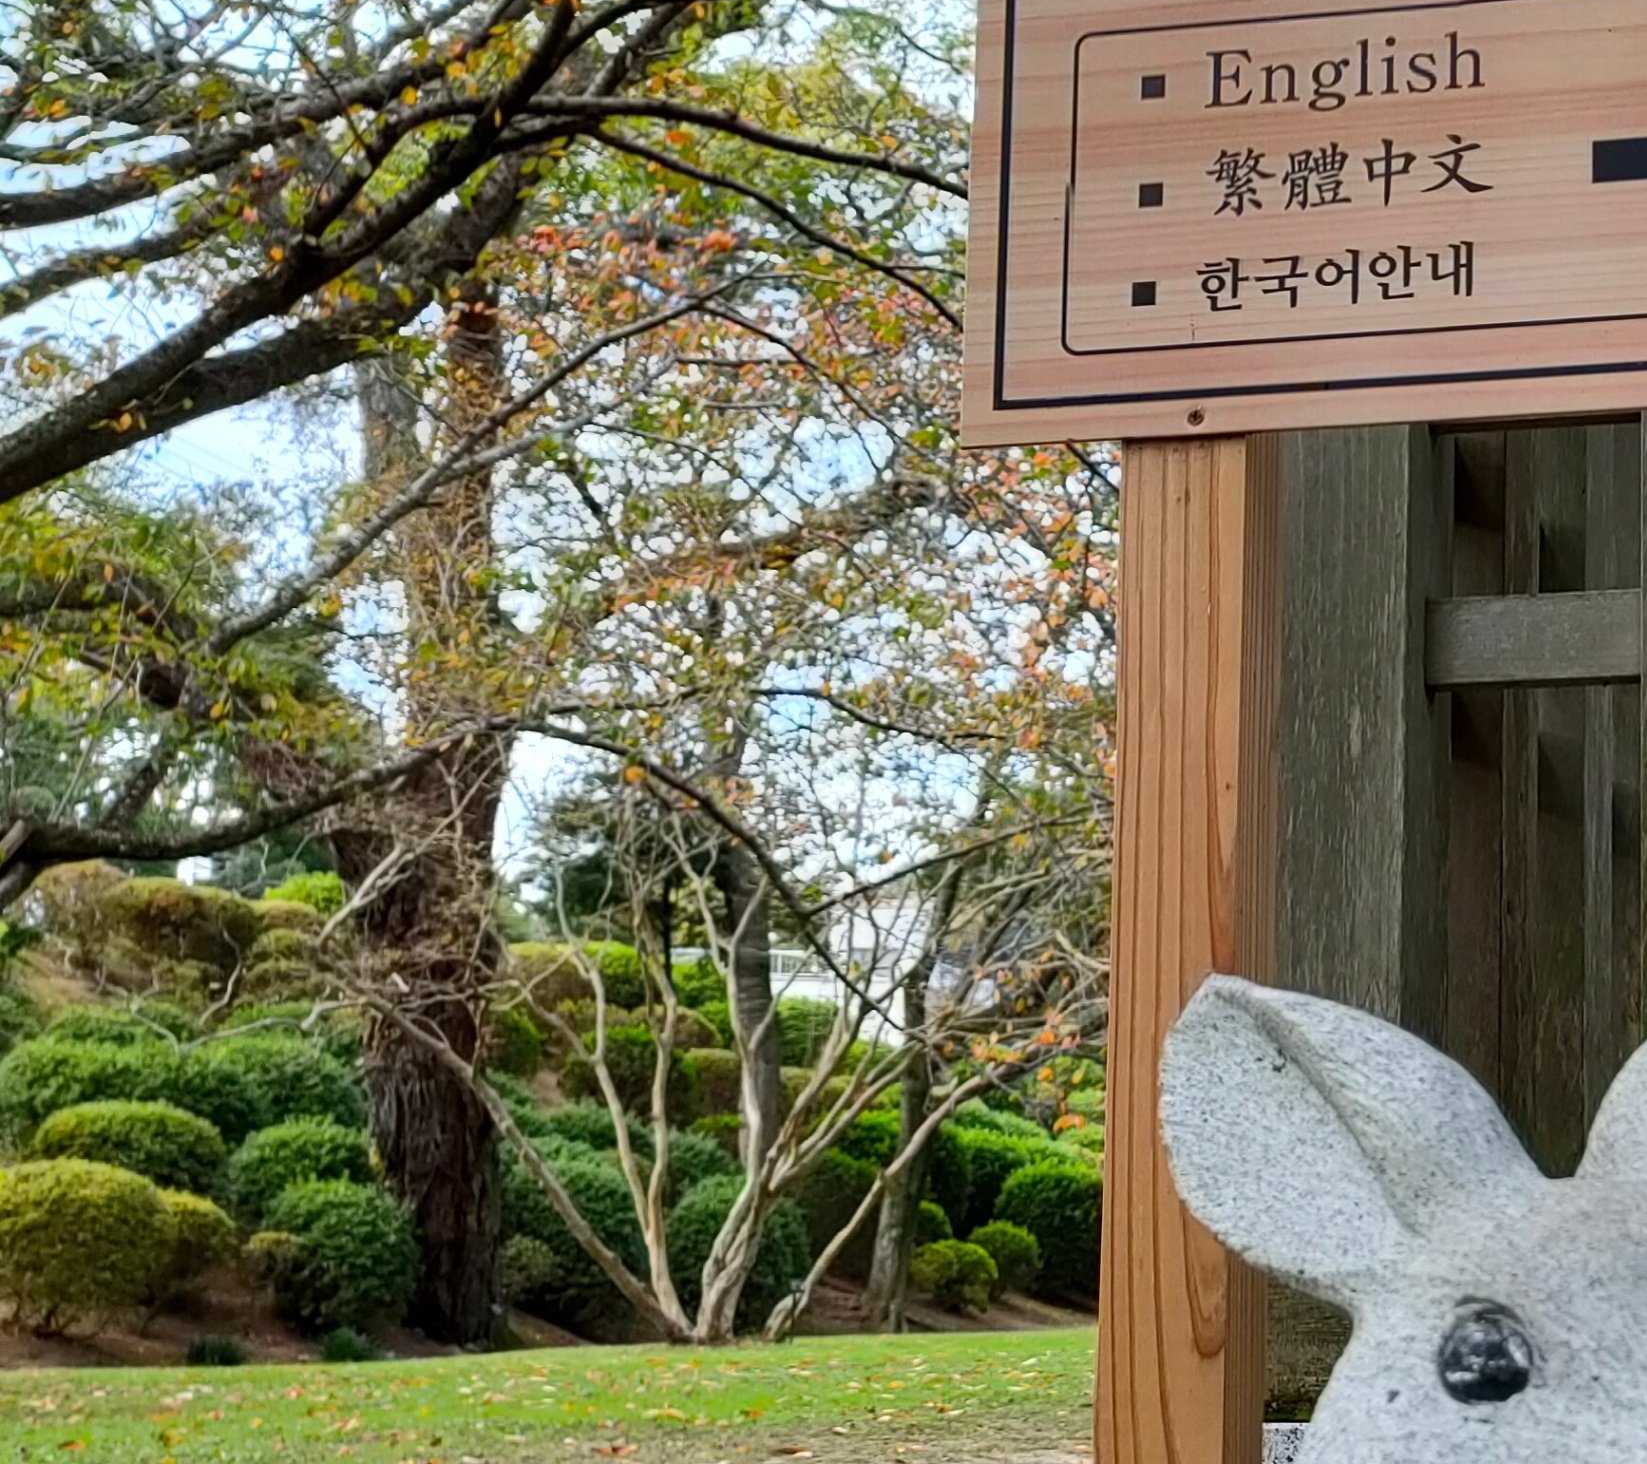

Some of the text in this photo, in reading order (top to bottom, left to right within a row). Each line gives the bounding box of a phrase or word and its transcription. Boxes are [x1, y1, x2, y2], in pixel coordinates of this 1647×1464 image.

[1203, 31, 1486, 111] English
[1205, 133, 1494, 217] 繁體中文
[1195, 241, 1476, 312] 한국어안내
